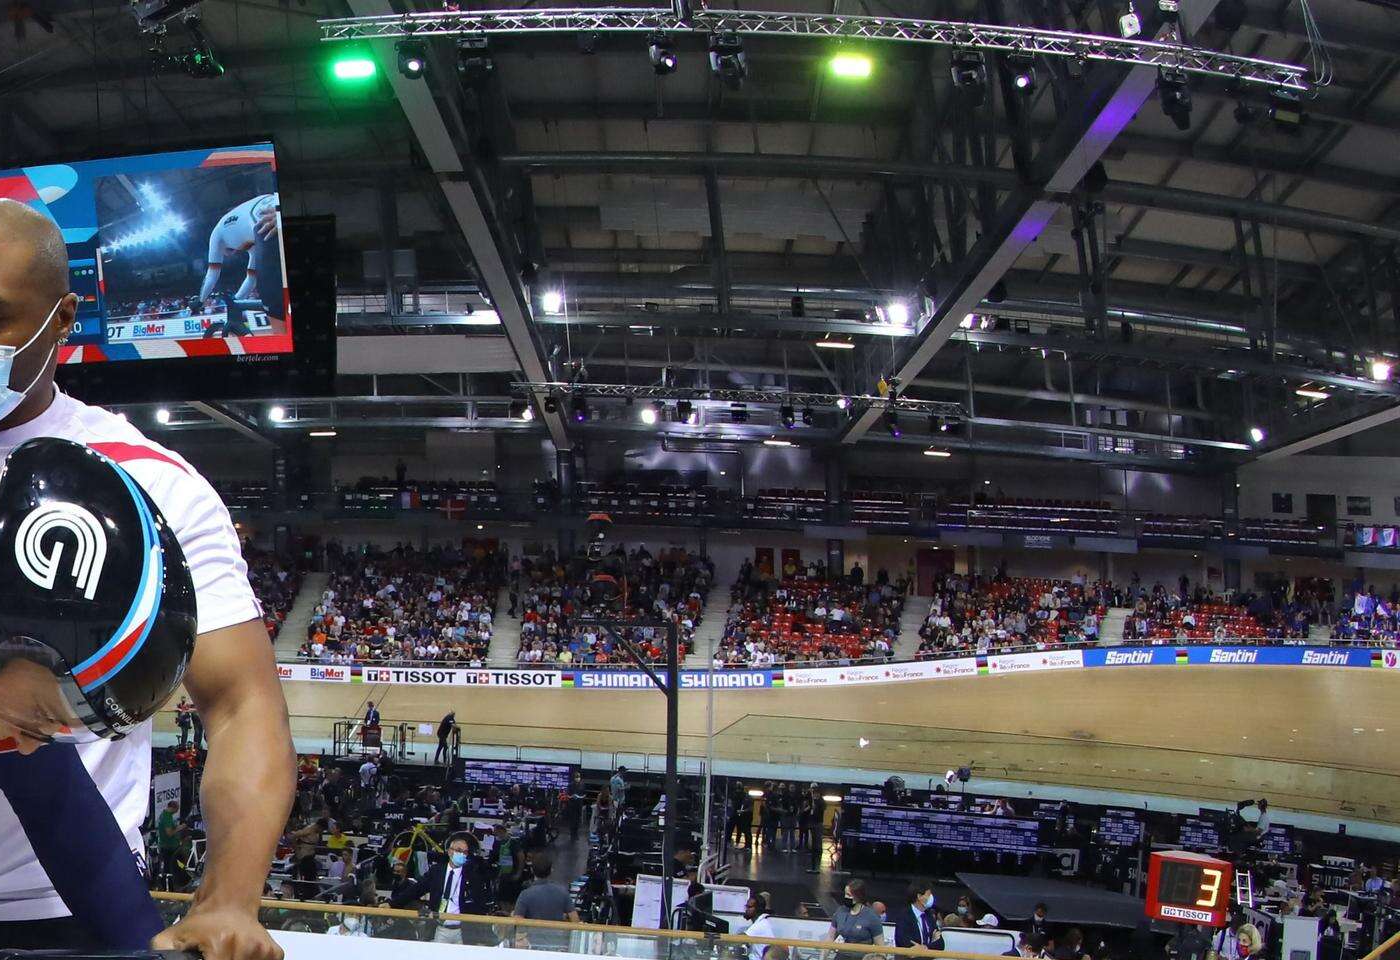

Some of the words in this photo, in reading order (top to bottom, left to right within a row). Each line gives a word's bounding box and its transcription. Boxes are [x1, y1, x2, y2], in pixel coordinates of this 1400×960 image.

[133, 324, 165, 336] BigMat
[1105, 649, 1153, 665] Santini
[1210, 649, 1258, 663] Santini
[1301, 650, 1349, 665] Santini
[310, 668, 344, 680] BigMat
[392, 670, 457, 683] TISSOT
[495, 672, 556, 685] TISSOT
[1196, 868, 1222, 908] 3
[1177, 909, 1210, 921] TISSOT
